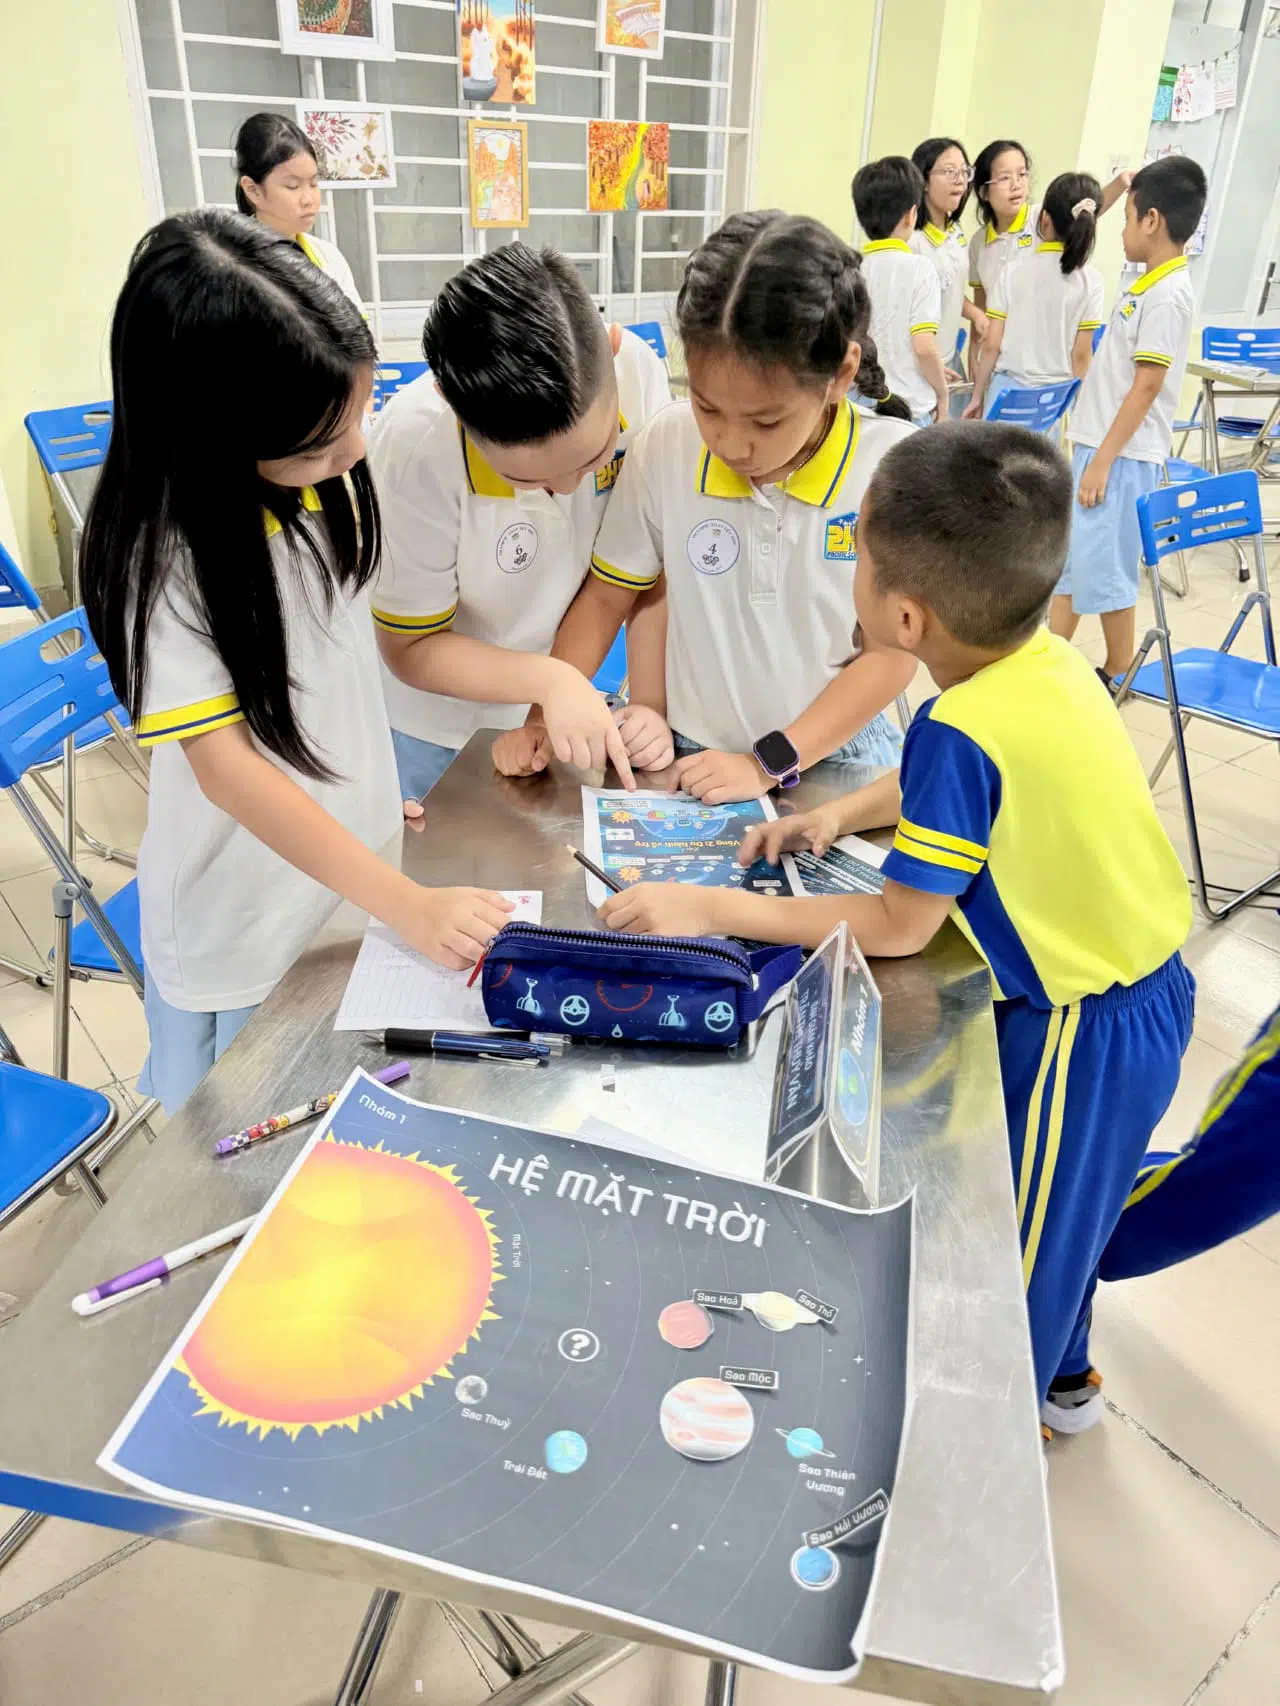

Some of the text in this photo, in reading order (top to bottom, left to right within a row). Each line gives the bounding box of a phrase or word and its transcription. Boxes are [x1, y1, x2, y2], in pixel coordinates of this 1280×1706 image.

[515, 544, 523, 555] 6
[708, 543, 718, 555] 4
[850, 998, 867, 1056] Nhóm
[359, 1094, 407, 1124] Nhóm 1
[489, 1153, 767, 1248] HỆ MẶT TRỜI
[697, 1292, 717, 1303] Sao
[798, 1294, 816, 1310] Sao
[570, 1333, 591, 1357] ?
[724, 1369, 772, 1385] Sao Mộc
[461, 1407, 483, 1421] Sao
[503, 1459, 526, 1474] Trái
[798, 1463, 856, 1481] Sao Thiên
[810, 1530, 833, 1545] Sao
